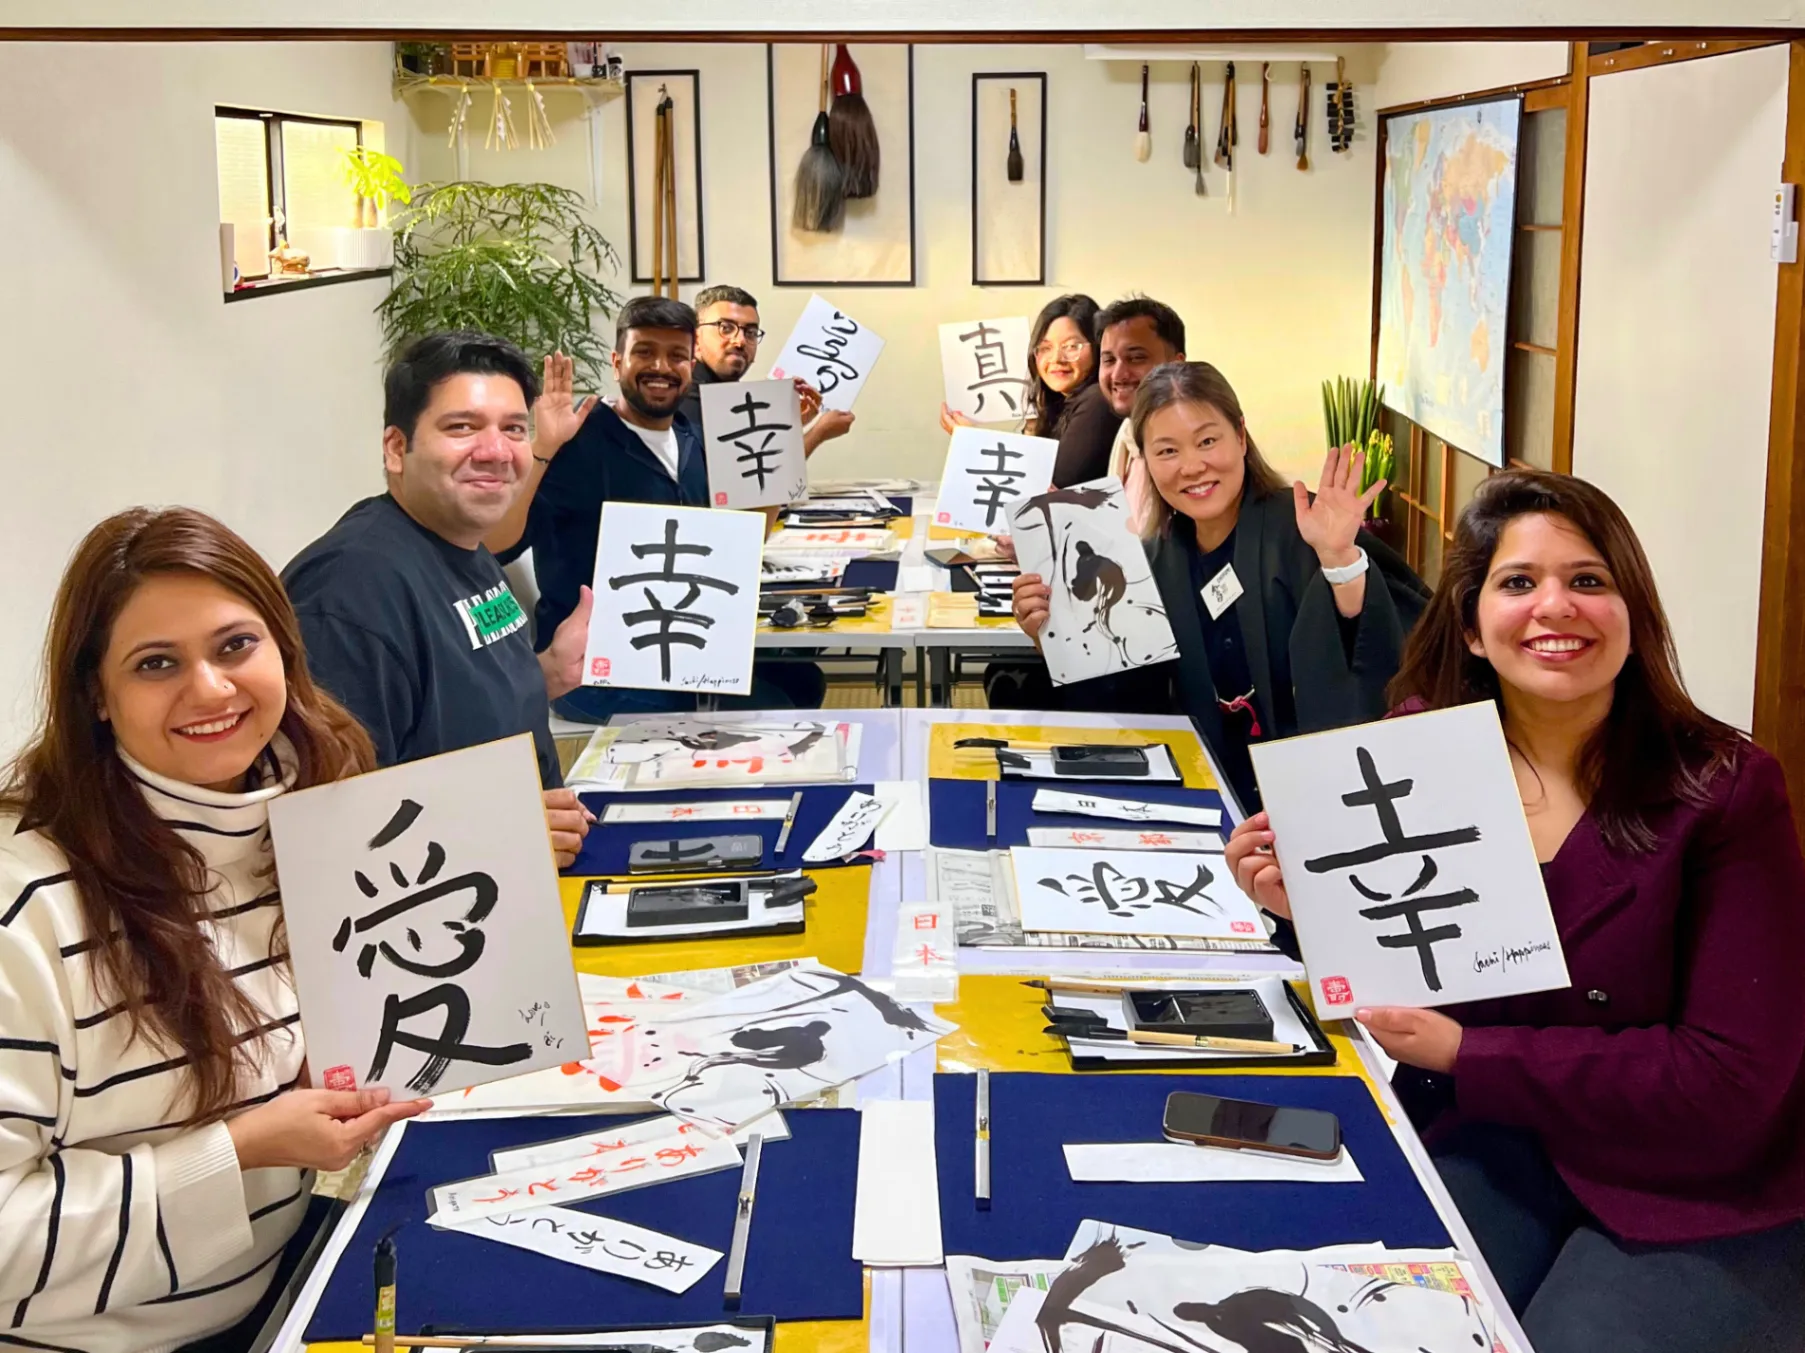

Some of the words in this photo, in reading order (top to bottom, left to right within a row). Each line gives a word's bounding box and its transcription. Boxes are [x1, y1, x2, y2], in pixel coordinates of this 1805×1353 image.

[958, 321, 1031, 414] 真
[716, 391, 792, 495] 幸
[965, 441, 1026, 528] 幸
[608, 518, 739, 683] 幸
[1036, 860, 1230, 919] 愛
[1303, 745, 1482, 993] 幸
[332, 798, 533, 1095] 愛
[914, 913, 945, 966] 日本
